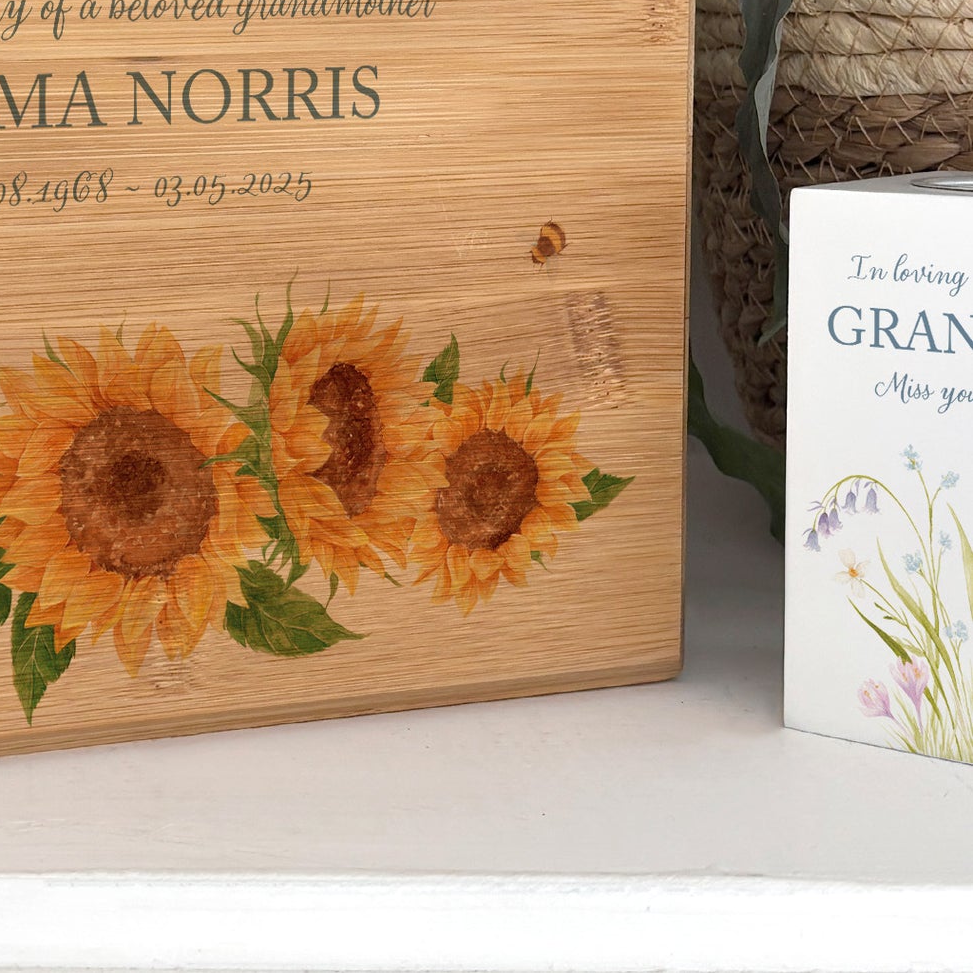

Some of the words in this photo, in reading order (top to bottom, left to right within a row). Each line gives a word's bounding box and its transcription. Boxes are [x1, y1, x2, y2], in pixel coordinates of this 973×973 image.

[126, 64, 381, 125] NORRIS
[154, 171, 314, 207] 03.05.2025
[847, 254, 888, 281] In
[893, 253, 970, 297] loving
[874, 371, 935, 404] Miss
